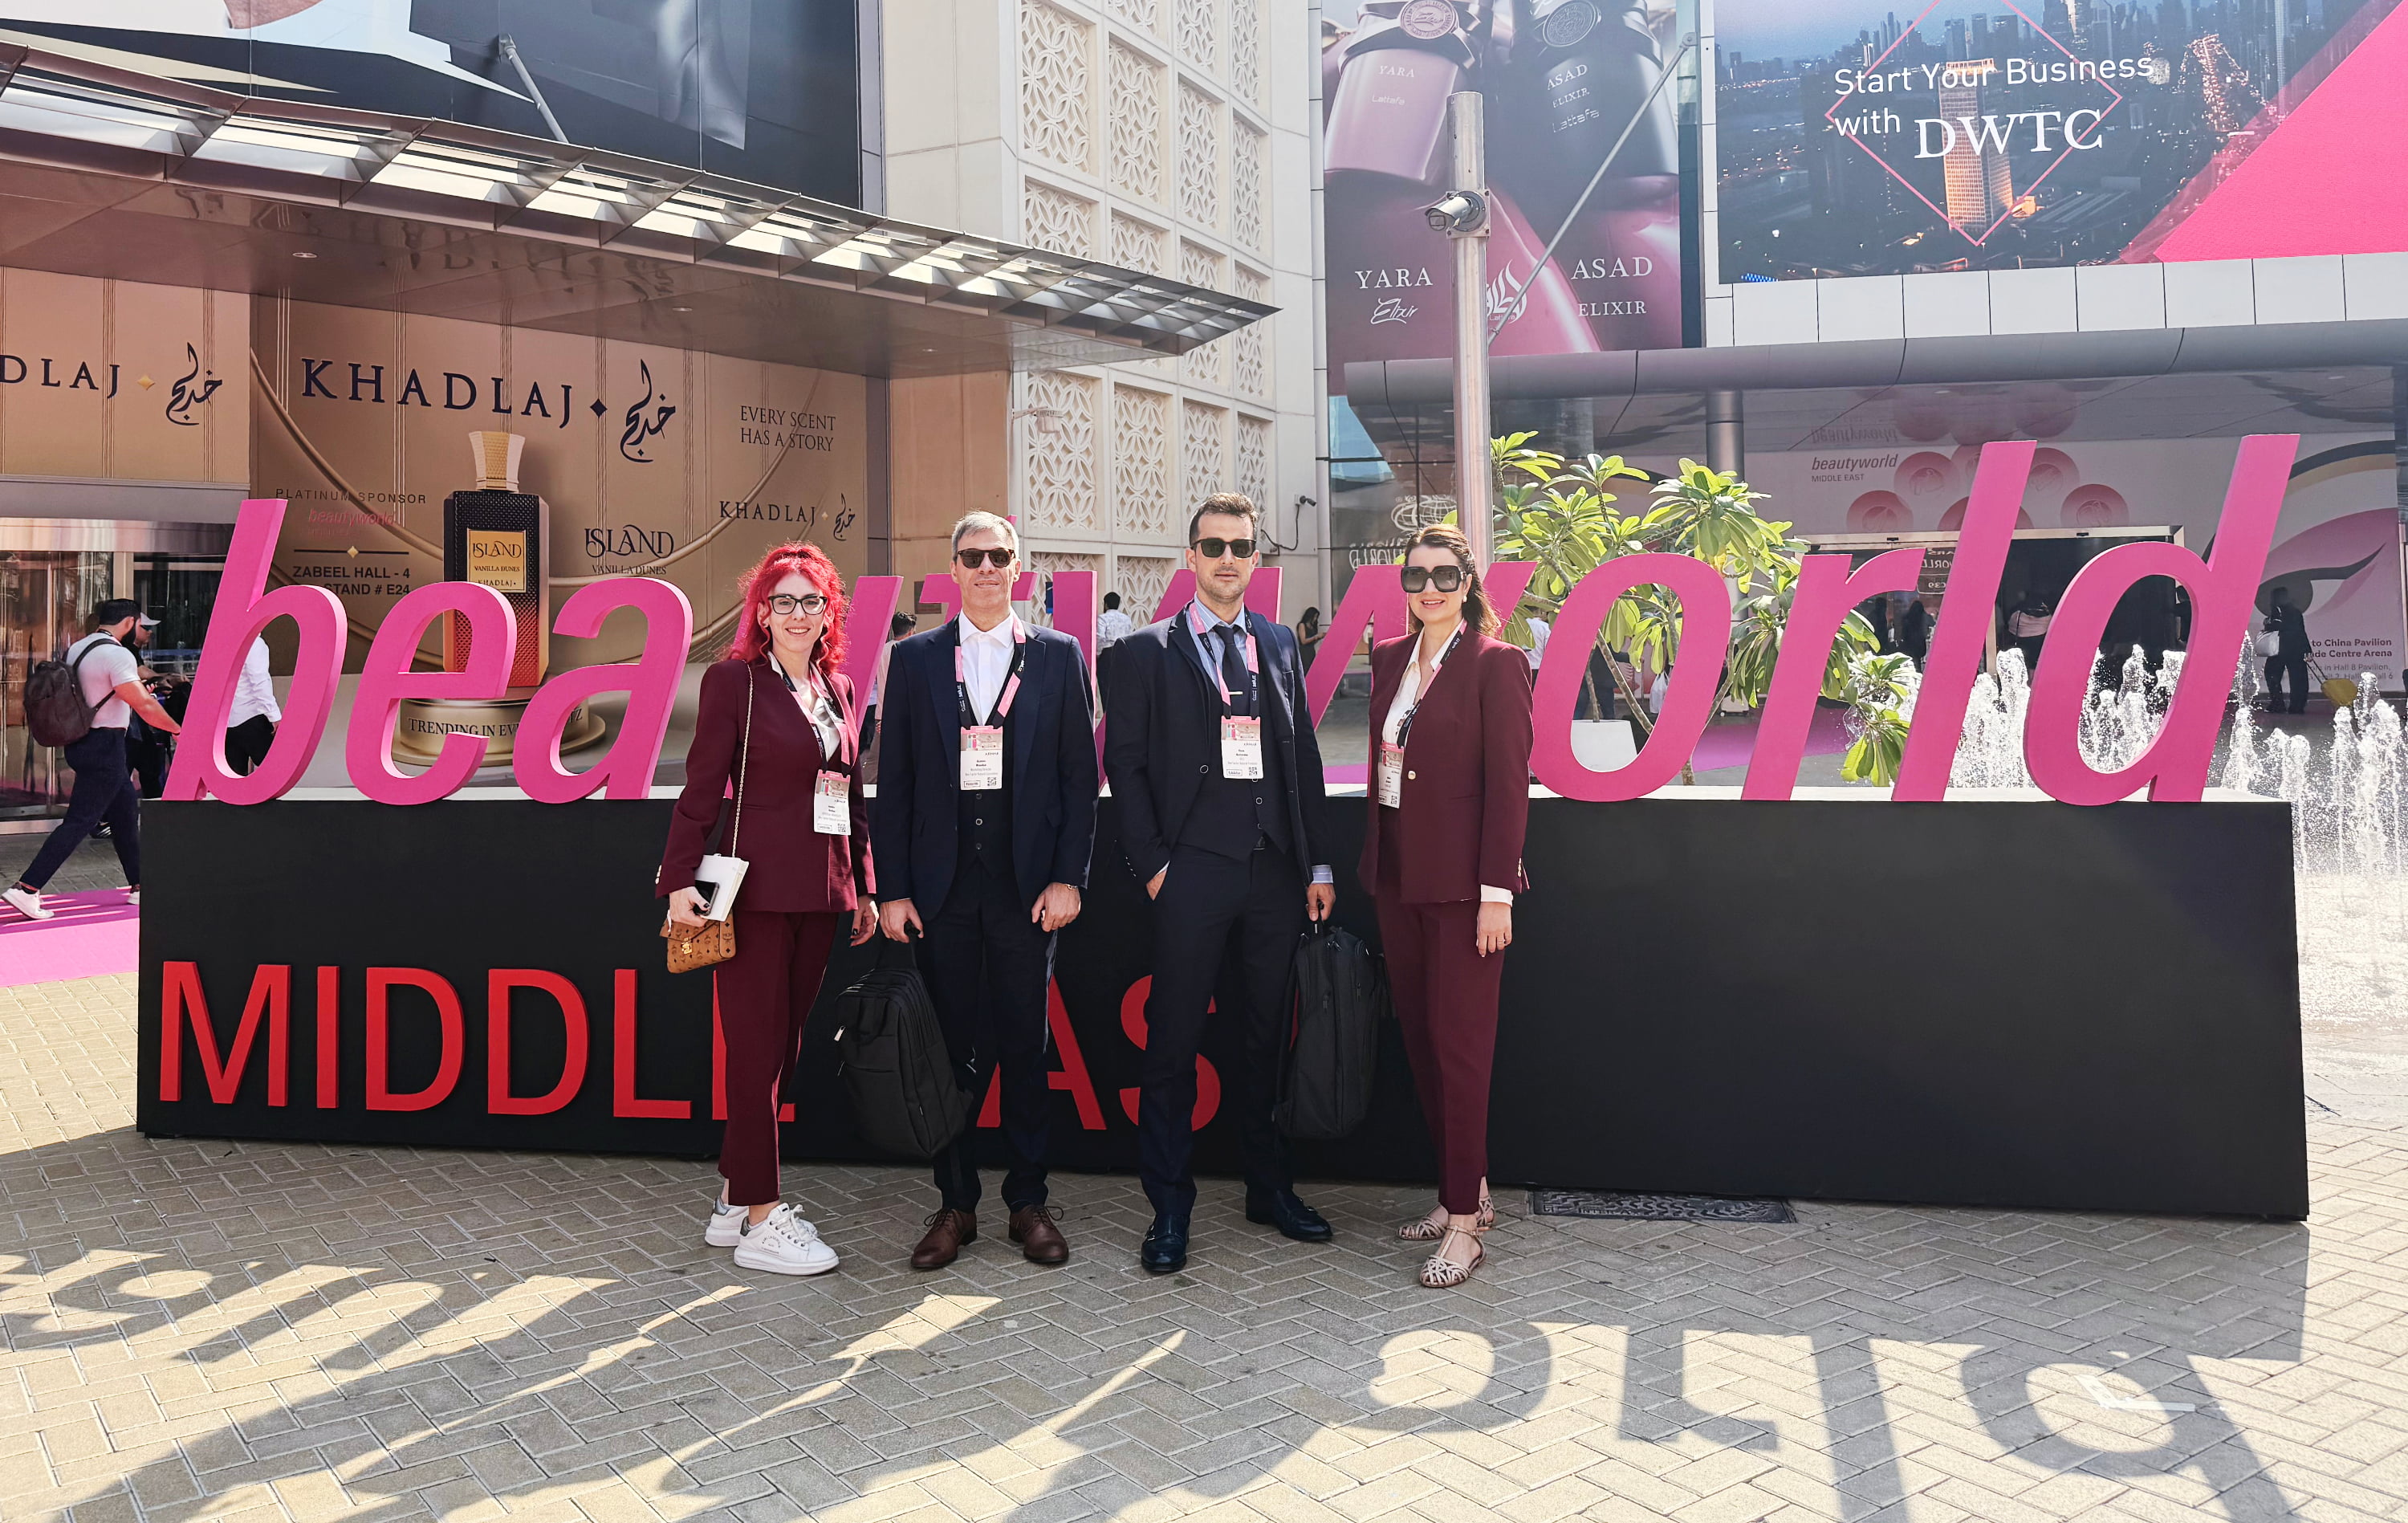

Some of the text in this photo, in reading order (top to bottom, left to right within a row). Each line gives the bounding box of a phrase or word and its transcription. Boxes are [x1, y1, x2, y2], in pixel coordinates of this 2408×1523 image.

[1377, 64, 1416, 78] YARA
[1546, 63, 1588, 91] ASAD
[1834, 55, 2154, 96] Start Your Business
[1552, 87, 1591, 109] ELIXIR
[1834, 108, 2104, 159] with DWTC
[1570, 256, 1653, 281] ASAD
[1355, 267, 1434, 290] YARA
[1369, 298, 1419, 325] Elixir
[1577, 300, 1647, 317] ELIXIR
[300, 357, 573, 430] KHADLAJ
[740, 405, 836, 431] EVERY SCENT
[740, 427, 835, 452] HAS A STORY
[1812, 454, 1899, 472] beautyworld
[1812, 474, 1842, 483] MIDDLE
[275, 488, 426, 504] PLATINUM SPONSOR
[308, 508, 395, 527] beautyworld
[719, 501, 816, 527] KHADLAJ
[472, 540, 523, 559] ISLAND
[584, 524, 675, 560] ISLAND
[293, 566, 351, 579] ZABEEL
[354, 567, 391, 579] HALL
[402, 568, 410, 579] 4
[474, 564, 520, 573] VANILLA DUNES
[592, 564, 667, 576] VANILLA DUNES
[386, 584, 411, 595] E24
[2324, 639, 2353, 647] China
[2354, 638, 2392, 646] Pavilion
[2329, 650, 2361, 658] Centre
[408, 718, 479, 736] TRENDING
[482, 724, 495, 737] IN
[159, 961, 795, 1121] MIDDL
